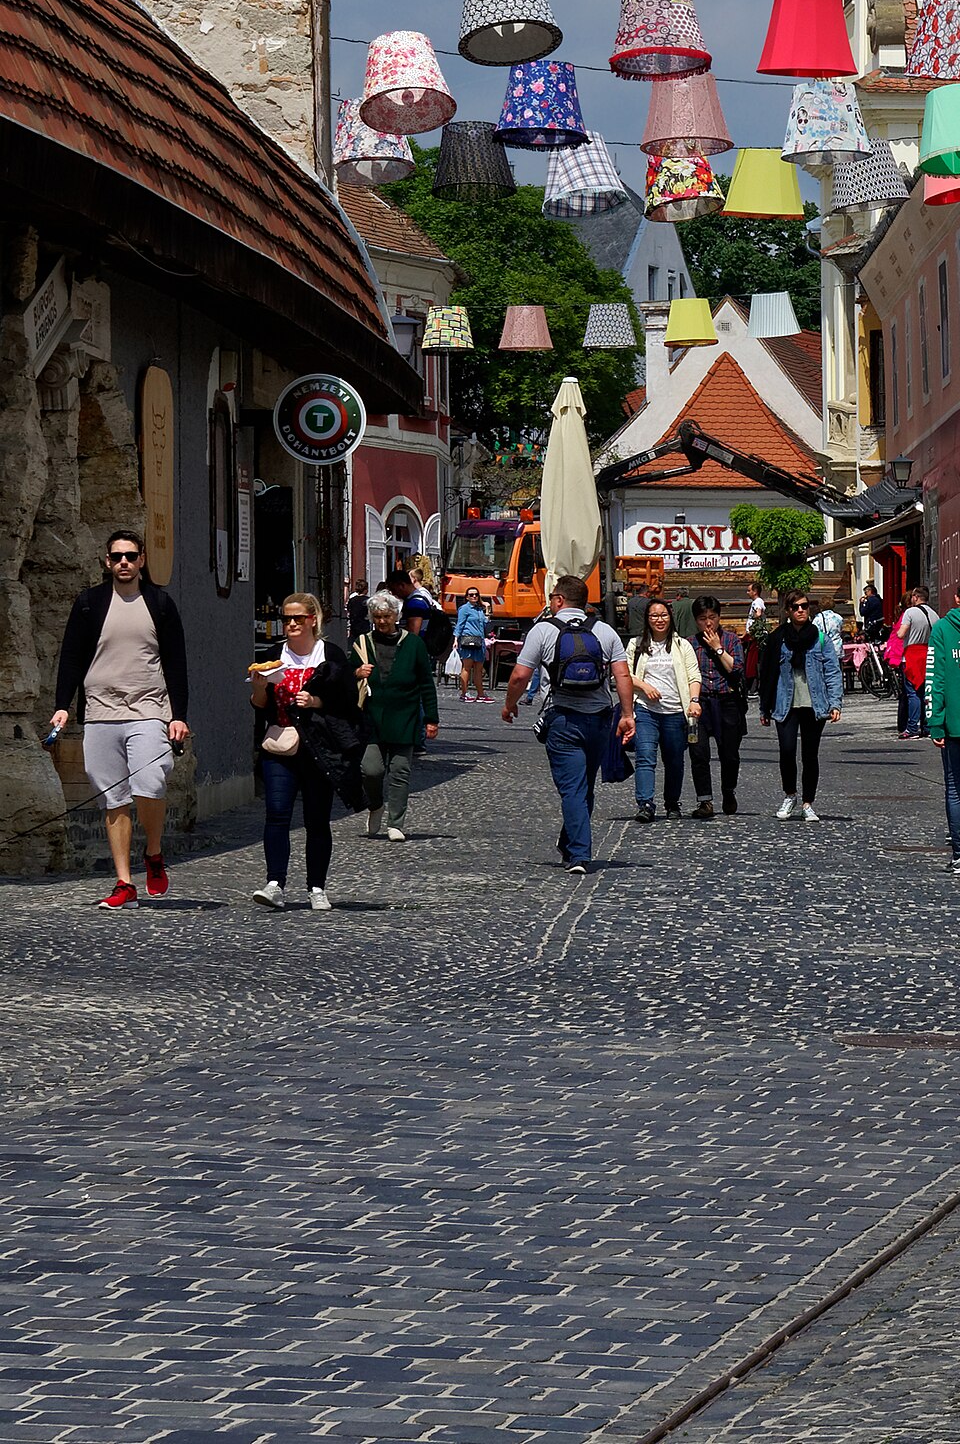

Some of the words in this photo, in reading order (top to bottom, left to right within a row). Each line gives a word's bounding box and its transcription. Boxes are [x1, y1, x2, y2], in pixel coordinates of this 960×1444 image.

[293, 382, 351, 403] NEMZETI
[312, 412, 329, 427] T
[282, 424, 356, 457] DOHÁNYBOLT
[628, 456, 649, 470] MKG
[925, 646, 935, 718] HOLLISTER
